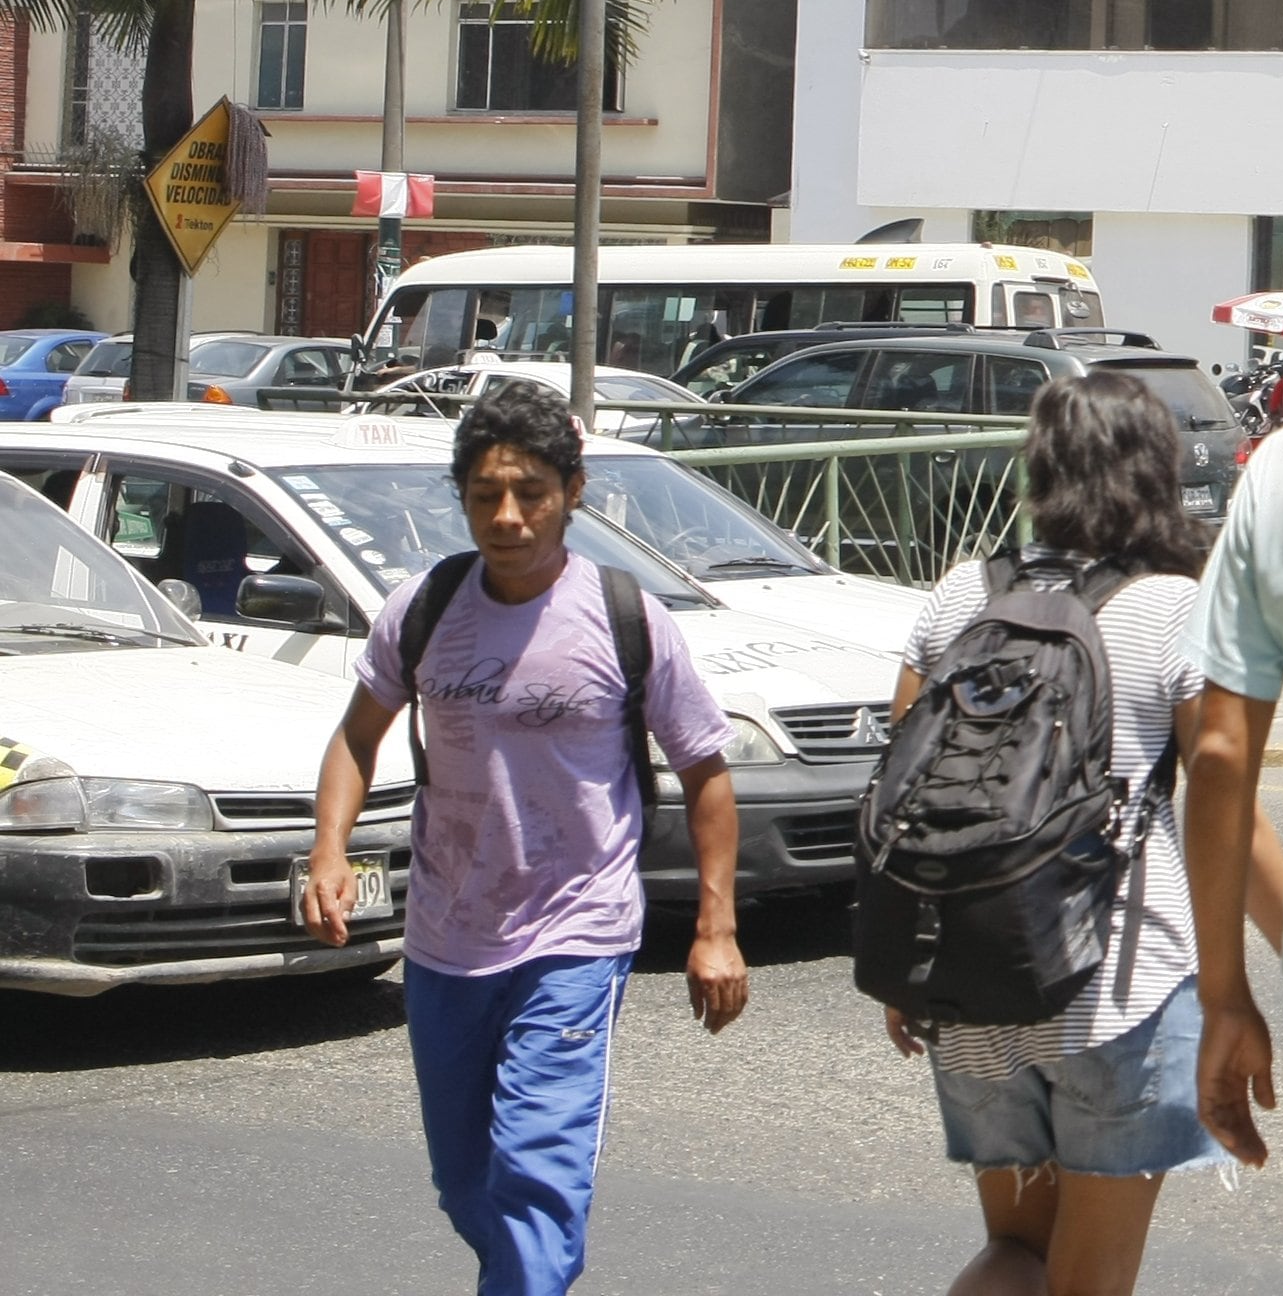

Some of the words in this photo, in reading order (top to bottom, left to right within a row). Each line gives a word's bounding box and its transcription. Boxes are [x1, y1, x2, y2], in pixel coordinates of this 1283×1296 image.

[189, 141, 228, 160] OBRA
[359, 424, 398, 446] TAXI
[209, 632, 248, 652] AXI
